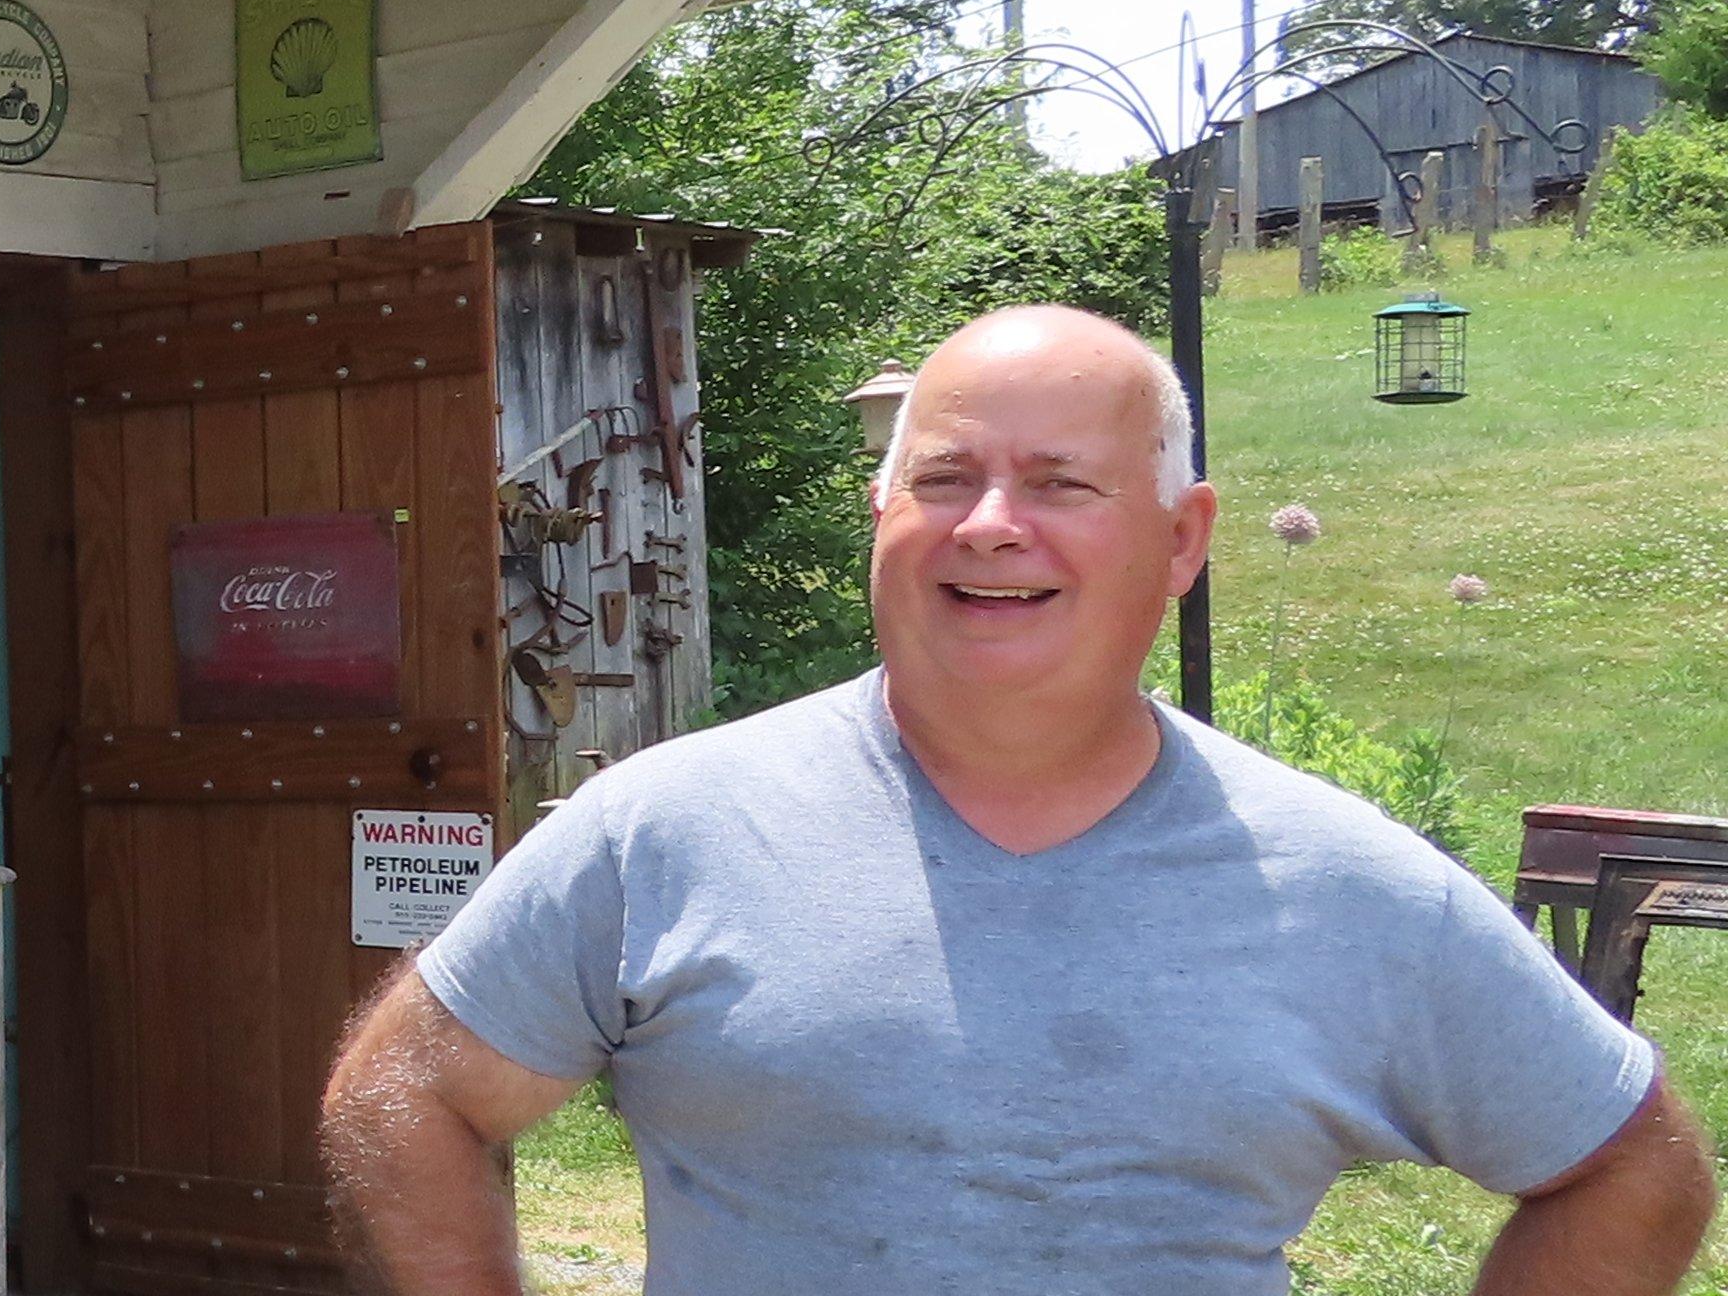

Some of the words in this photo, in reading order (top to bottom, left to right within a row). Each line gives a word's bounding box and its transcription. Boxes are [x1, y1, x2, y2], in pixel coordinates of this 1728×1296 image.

[34, 22, 66, 86] COMPANY
[247, 111, 317, 144] AUTO
[325, 105, 368, 132] OIL
[219, 570, 339, 613] Coca-Cola
[362, 821, 484, 847] WARNING
[364, 855, 481, 876] PETROLEUM
[375, 876, 468, 896] PIPELINE
